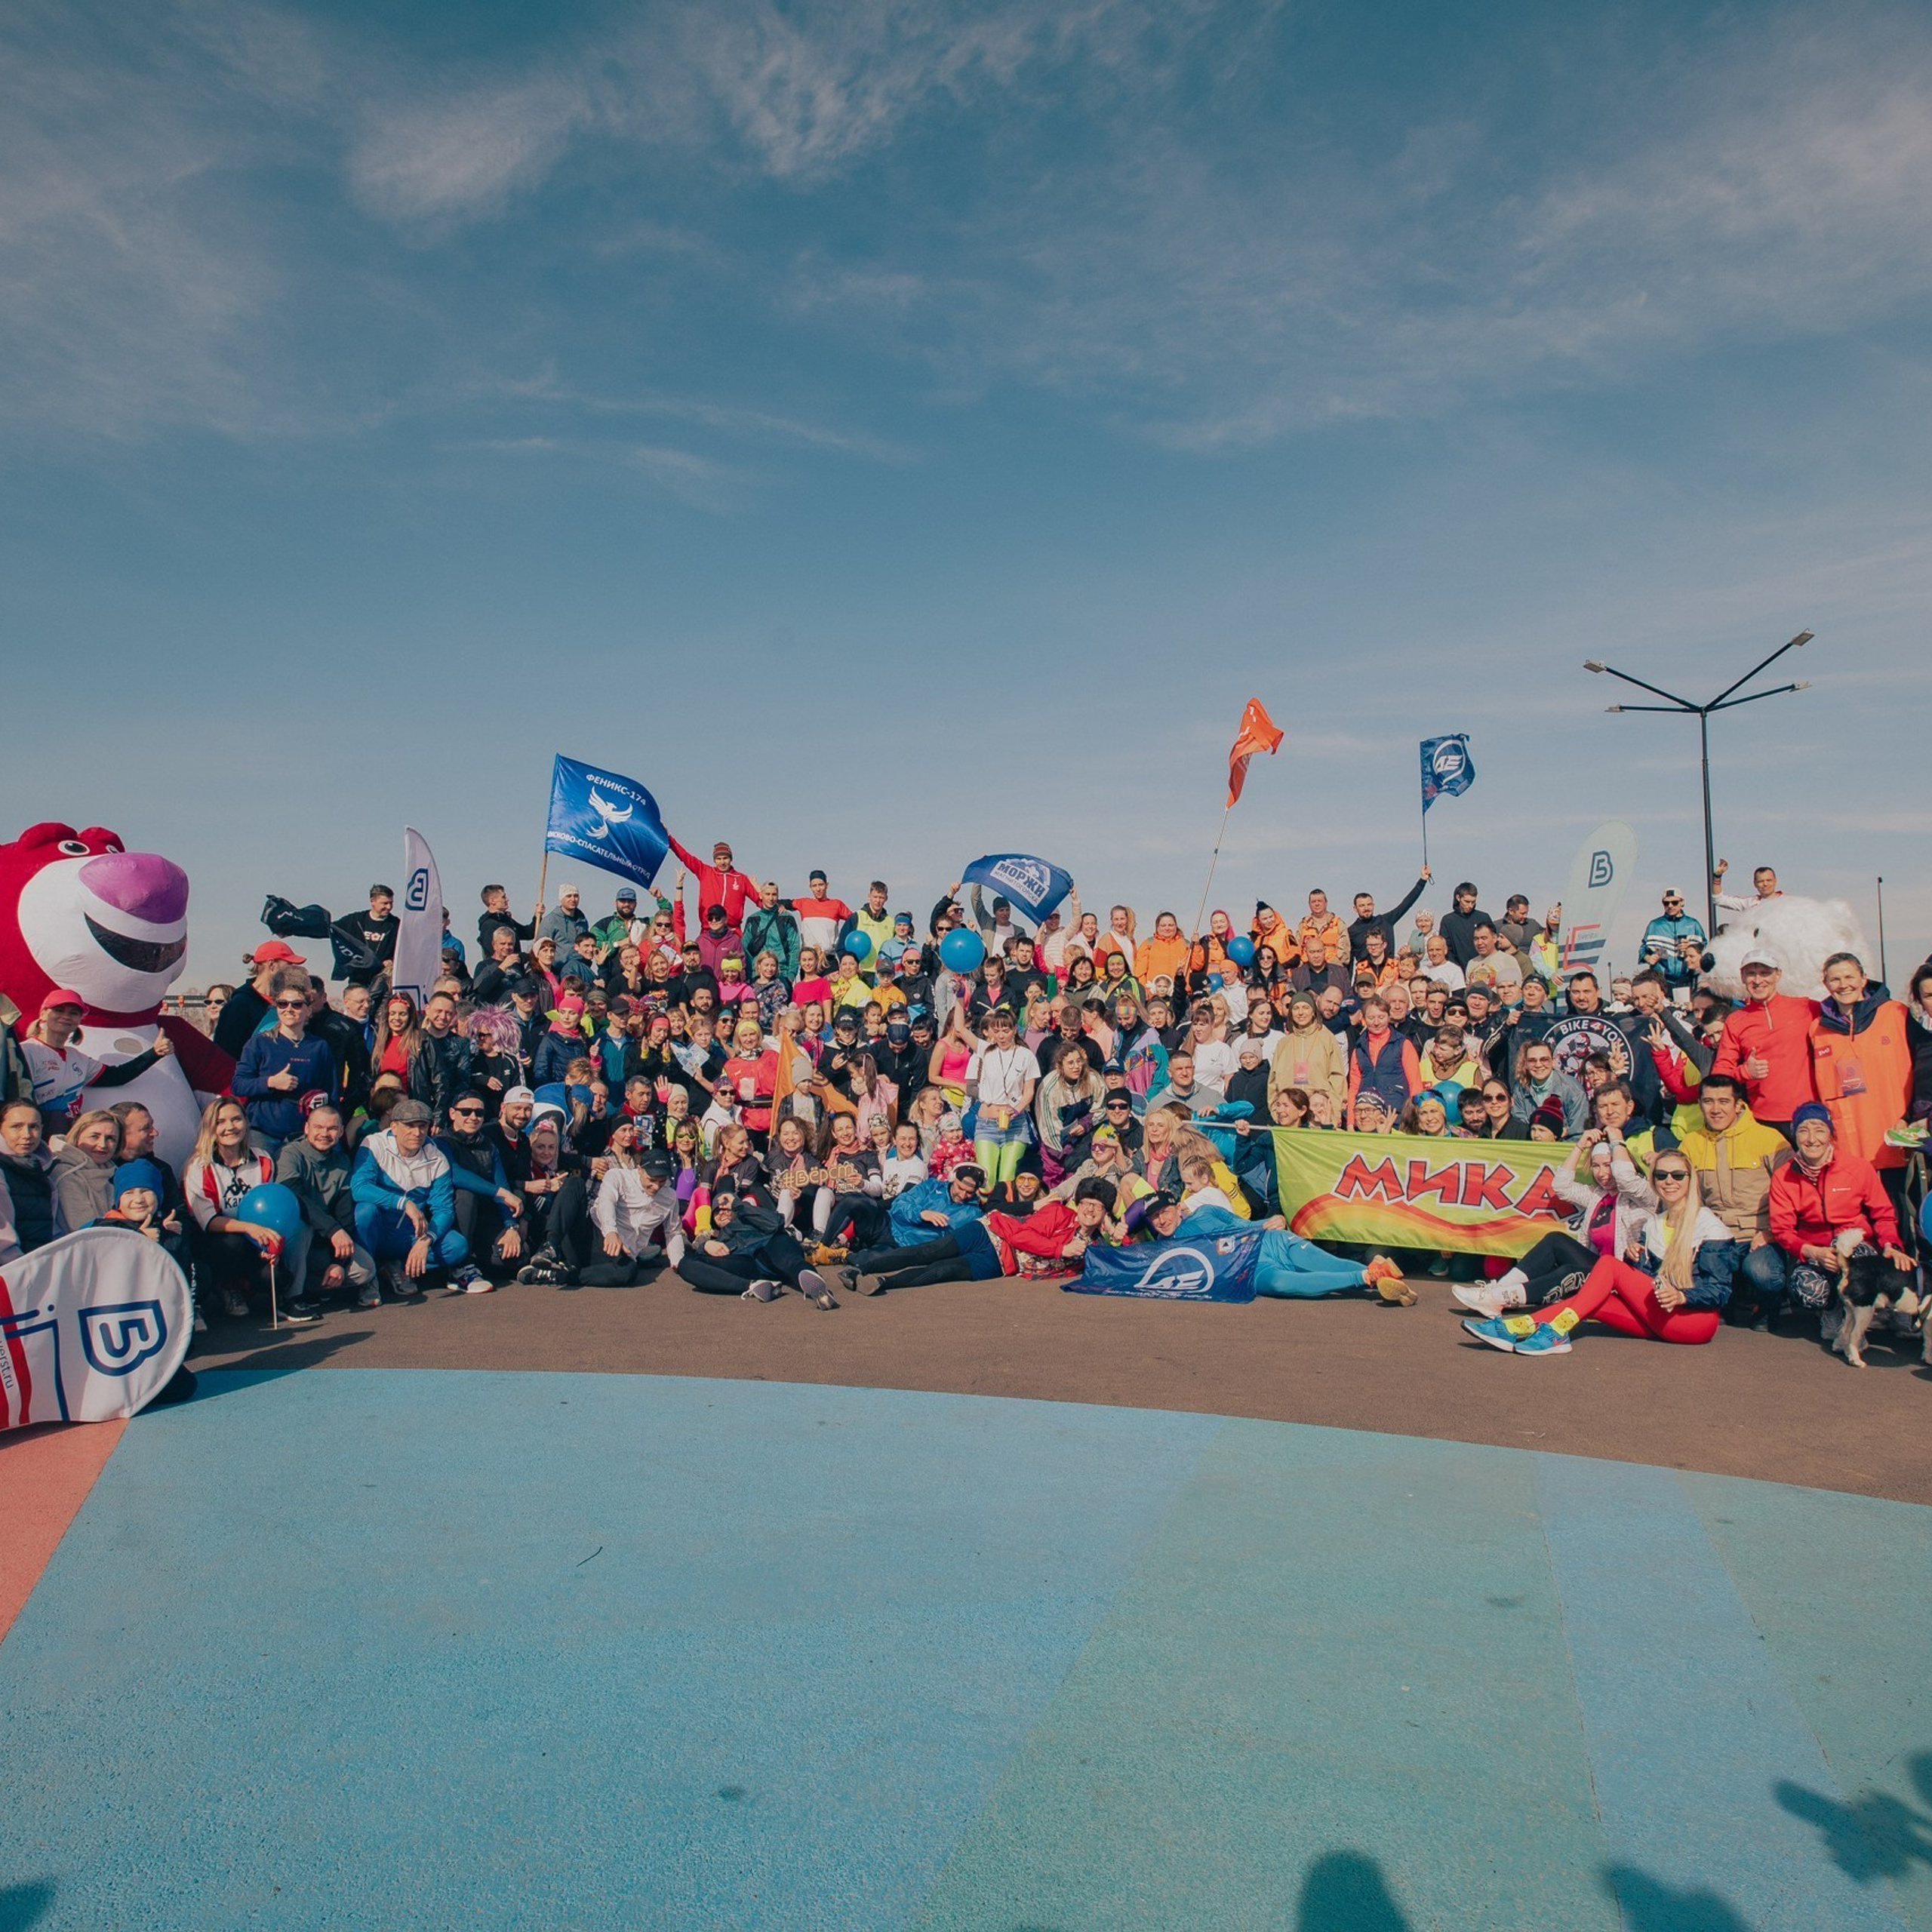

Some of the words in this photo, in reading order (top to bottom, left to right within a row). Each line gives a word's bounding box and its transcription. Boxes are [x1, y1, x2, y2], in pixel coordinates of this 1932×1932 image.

[586, 774, 646, 805] ФЕНИКС-174
[997, 863, 1046, 898] МОРЖИ
[1333, 1153, 1580, 1220] МИКА
